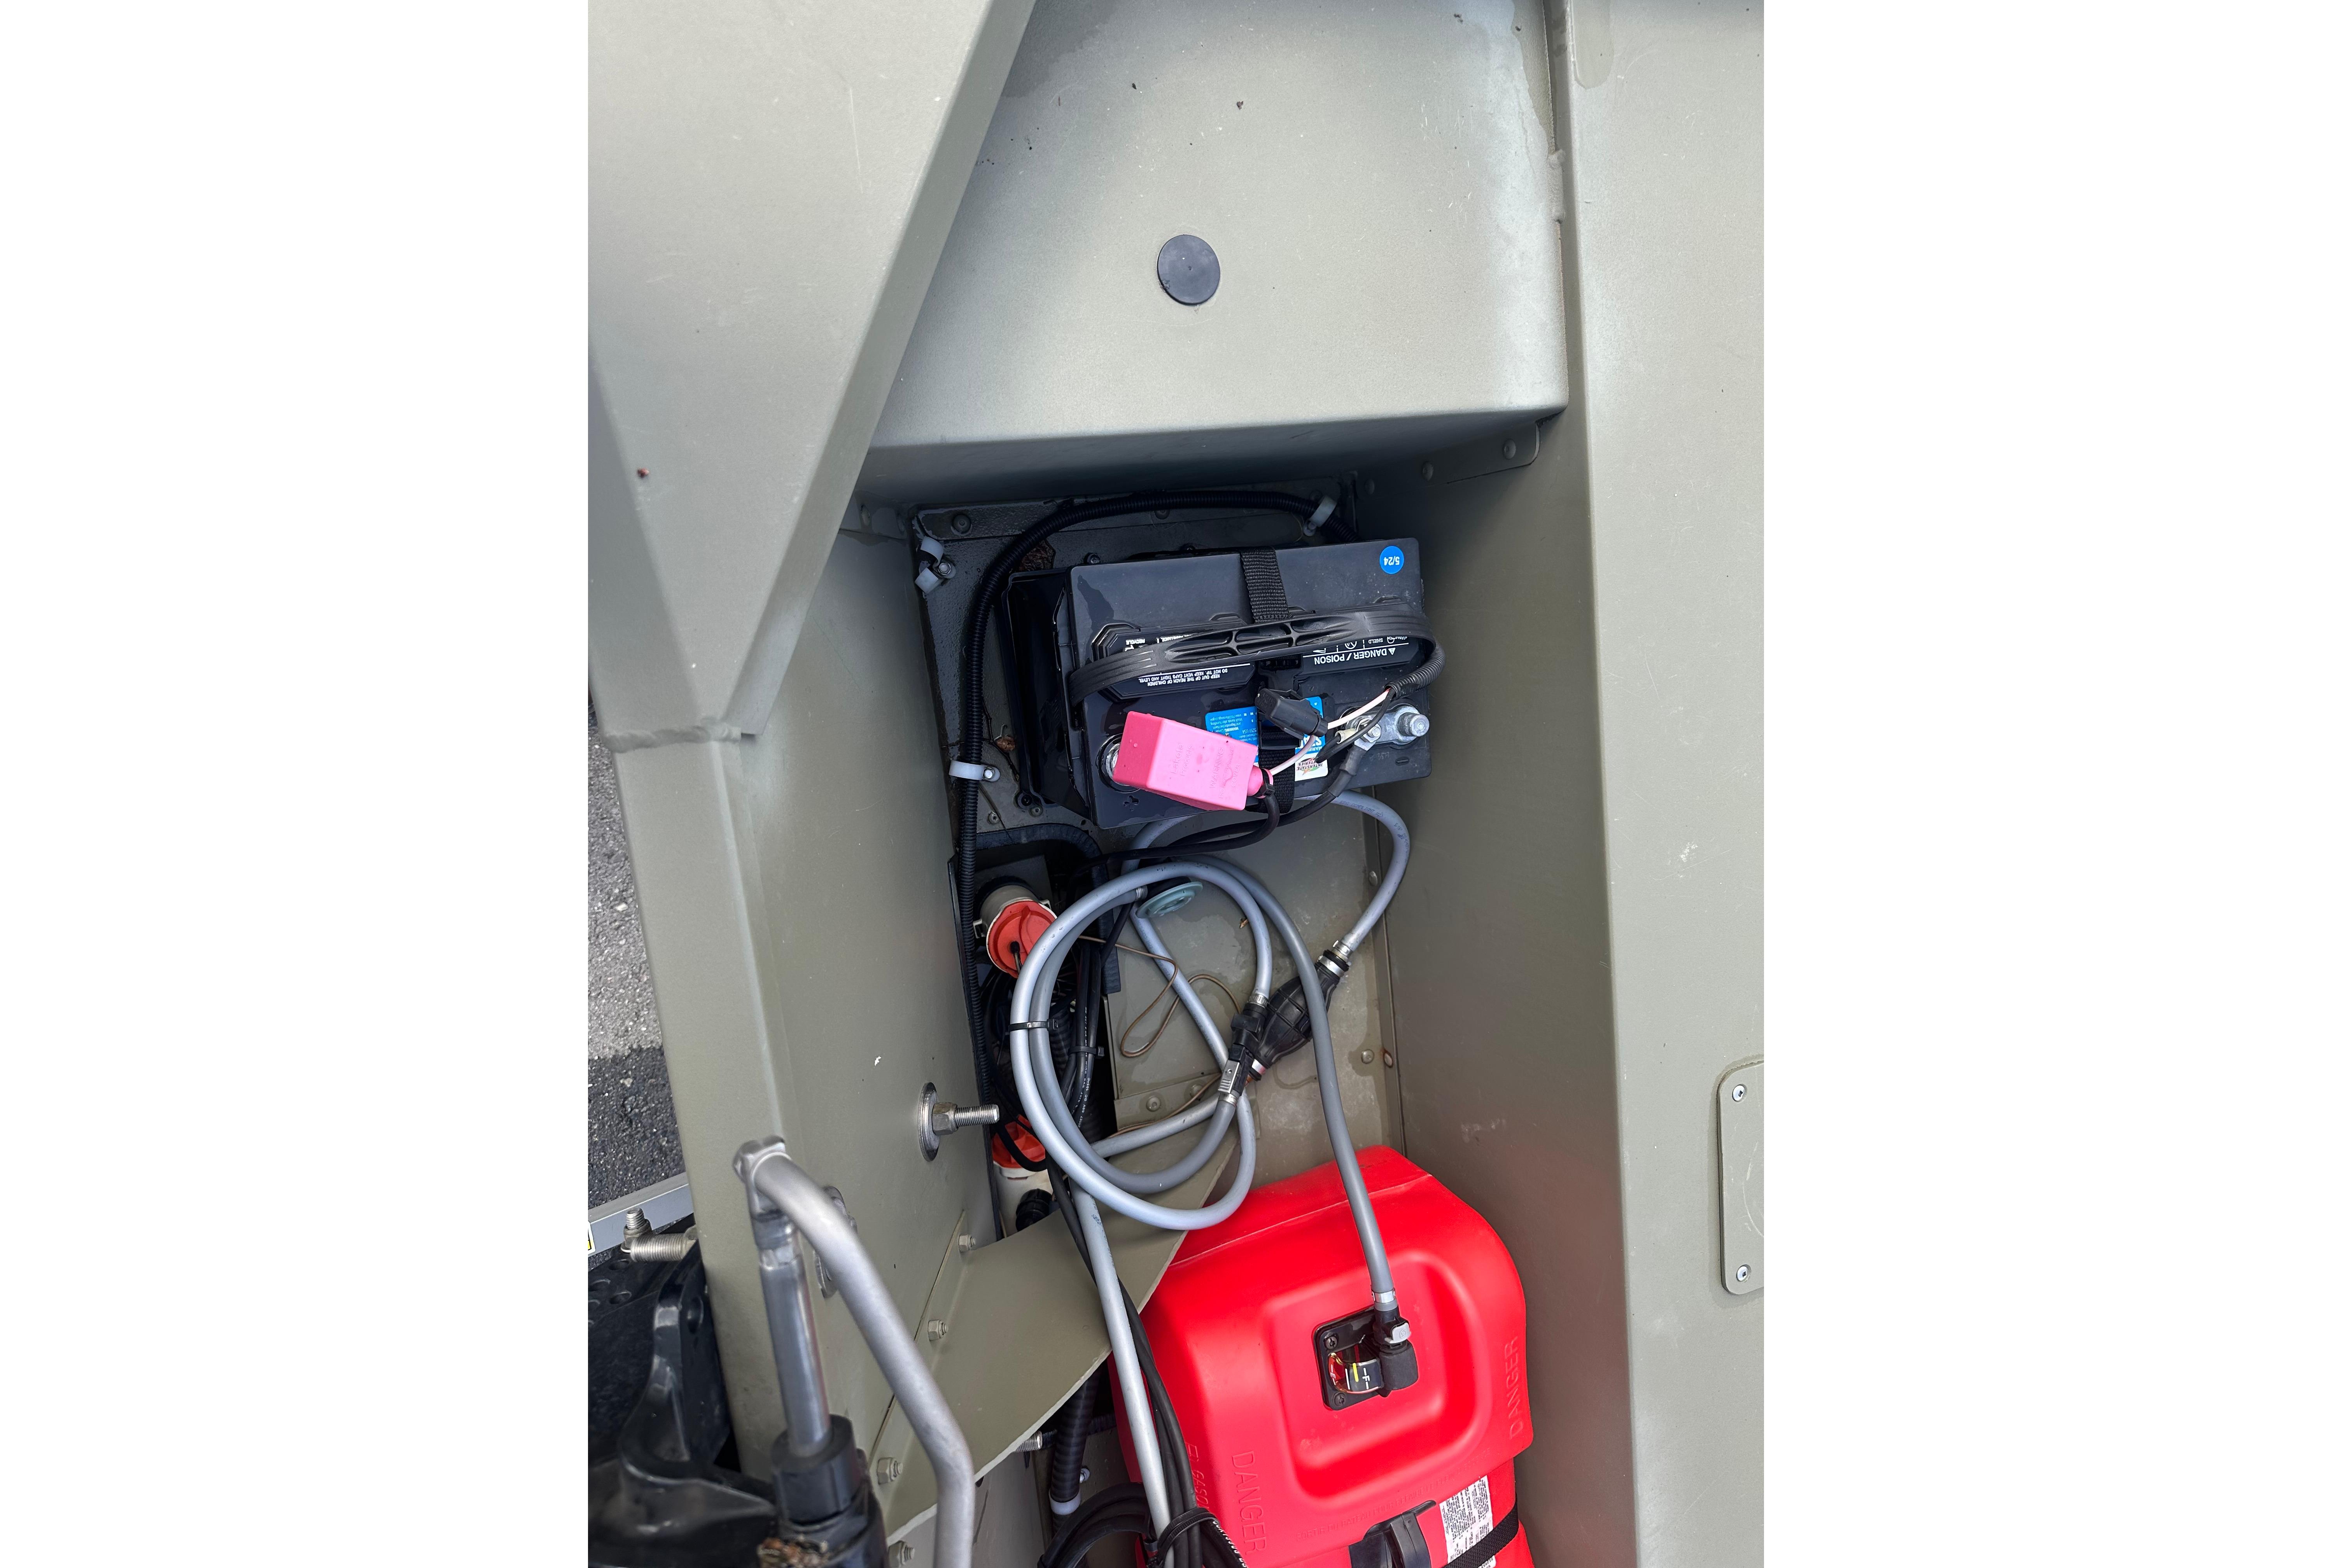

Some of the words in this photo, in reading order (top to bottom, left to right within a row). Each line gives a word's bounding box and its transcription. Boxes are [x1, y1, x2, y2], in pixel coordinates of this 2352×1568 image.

[1384, 555, 1400, 565] 5/24
[1314, 655, 1345, 665] POISON
[1353, 648, 1387, 659] DANGER
[1171, 744, 1183, 774] Lakota
[1180, 744, 1192, 776] Products
[1209, 747, 1224, 788] WARNING
[1232, 763, 1240, 788] COVER
[1219, 788, 1225, 799] DO
[1505, 1336, 1523, 1439] DANGER
[1232, 1451, 1267, 1556] DANGER
[1296, 1526, 1326, 1541] SORTIR
[1328, 1522, 1339, 1532] DU
[1342, 1511, 1371, 1527] BATEAU
[1373, 1502, 1393, 1515] POUR
